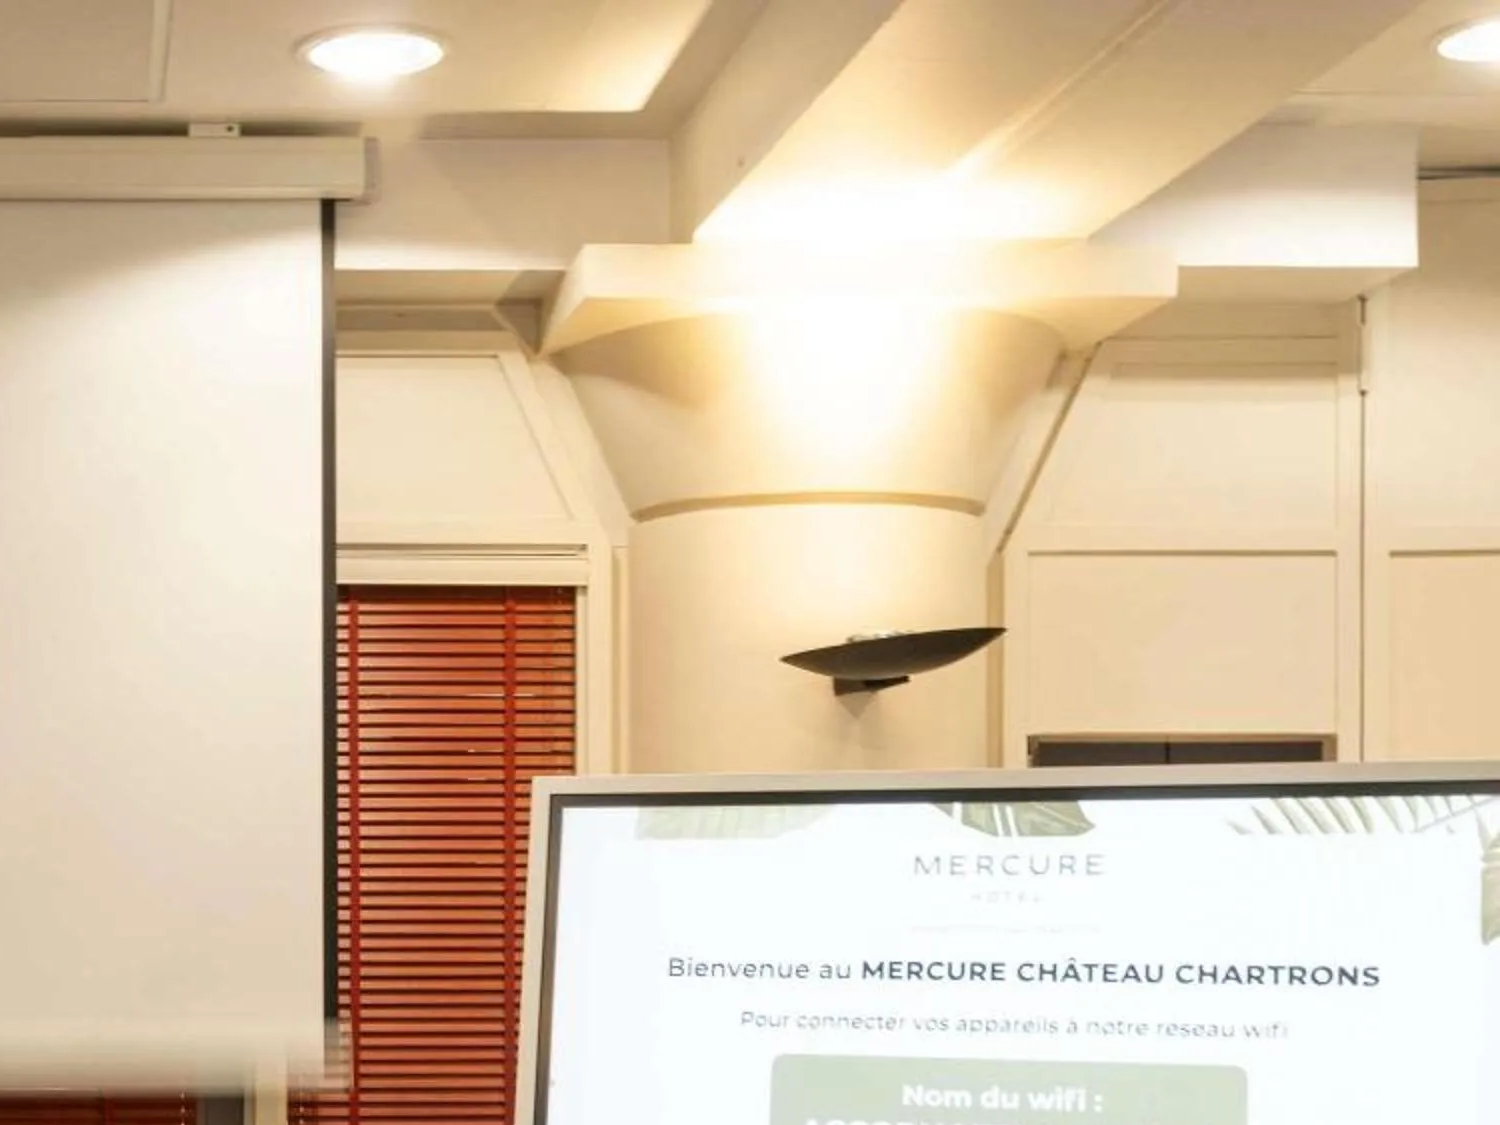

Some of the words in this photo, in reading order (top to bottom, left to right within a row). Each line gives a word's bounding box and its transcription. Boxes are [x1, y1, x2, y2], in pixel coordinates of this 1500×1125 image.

[913, 854, 1106, 876] MERCURE
[667, 956, 810, 980] Bienvenue
[818, 962, 852, 980] au
[860, 960, 1007, 982] MERCURE
[1016, 956, 1165, 984] CHÂTEAU
[1174, 962, 1381, 988] CHARTRONS
[740, 1010, 789, 1029] Pour
[795, 1011, 905, 1032] connecter
[912, 1015, 950, 1033] vos
[955, 1014, 1059, 1036] appareils
[1085, 1017, 1151, 1036] notre
[1242, 1021, 1290, 1040] wifi
[901, 1084, 972, 1110] Nom
[980, 1086, 1019, 1111] du
[1027, 1087, 1087, 1114] wifi
